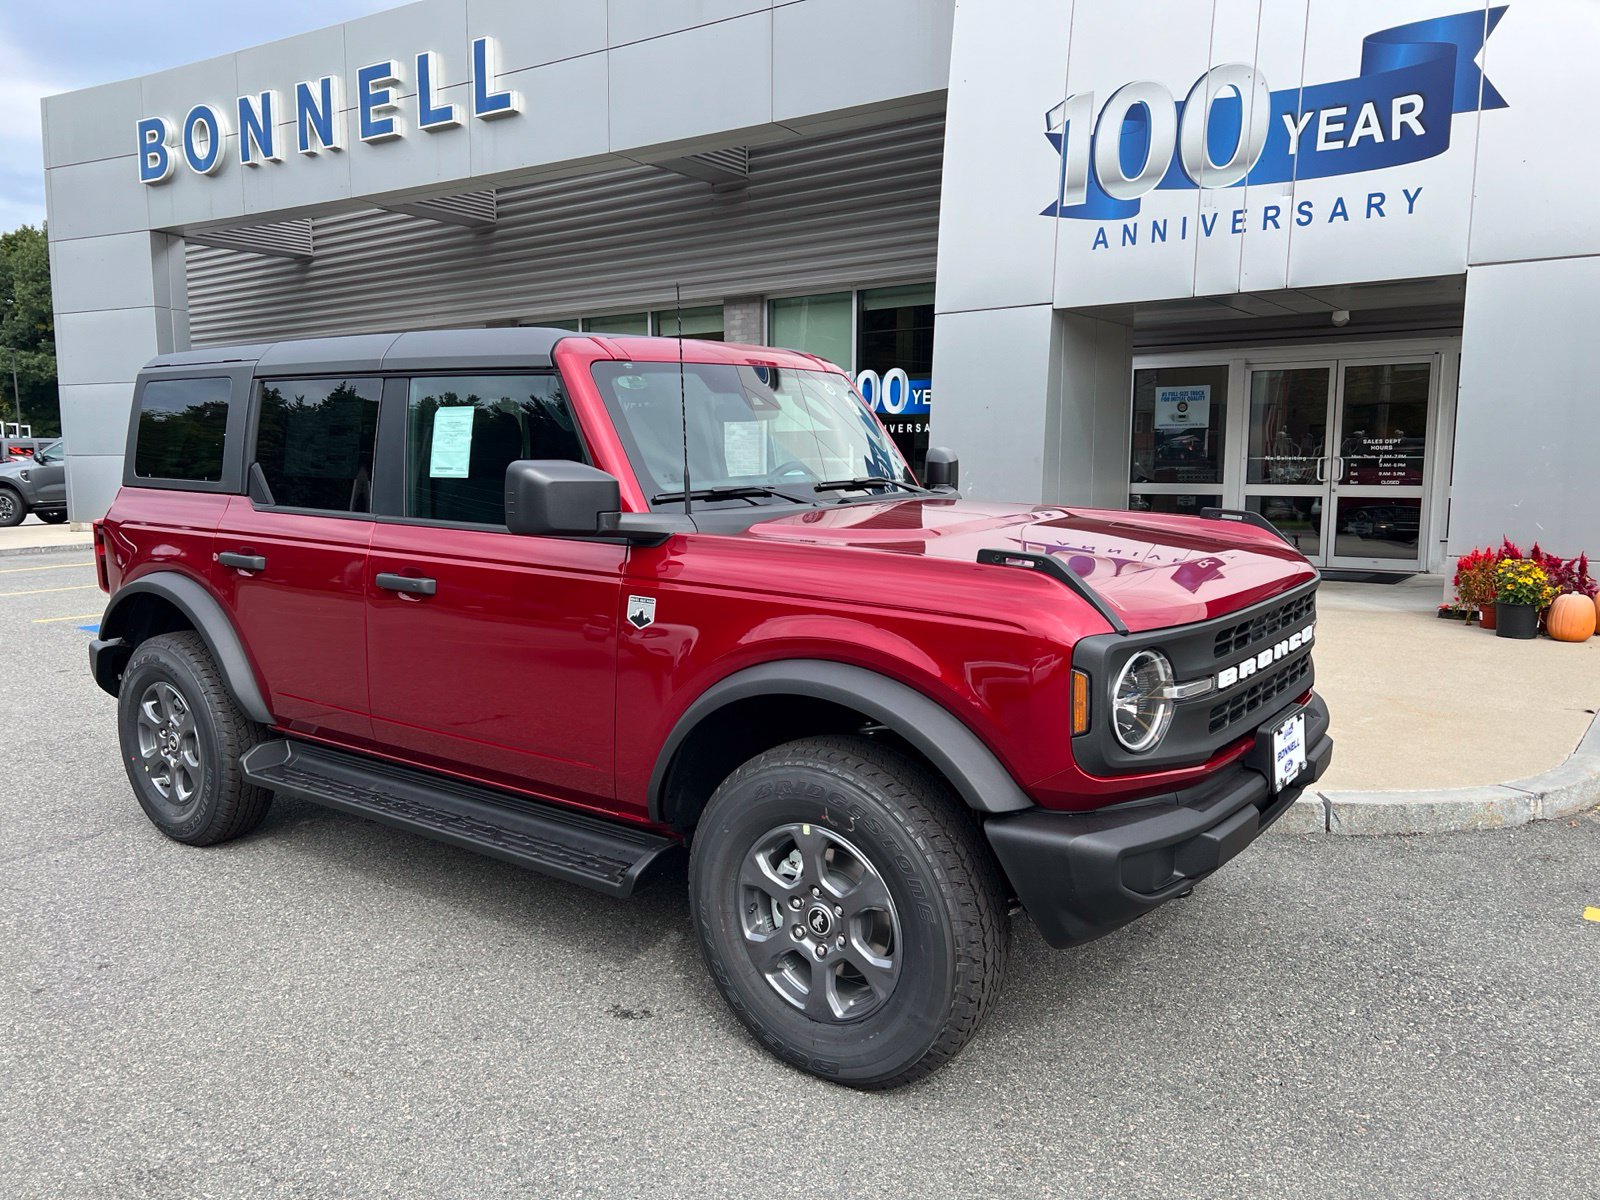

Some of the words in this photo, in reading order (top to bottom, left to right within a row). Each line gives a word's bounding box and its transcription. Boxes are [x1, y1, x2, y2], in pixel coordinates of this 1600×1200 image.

[136, 35, 520, 184] BONNELL
[1046, 61, 1270, 206] 100
[1282, 93, 1426, 155] YEAR
[1092, 187, 1424, 250] ANNIVERSARY
[846, 367, 910, 415] 00
[1217, 624, 1314, 689] BRONCO
[752, 778, 938, 927] BRIDGESTONE
